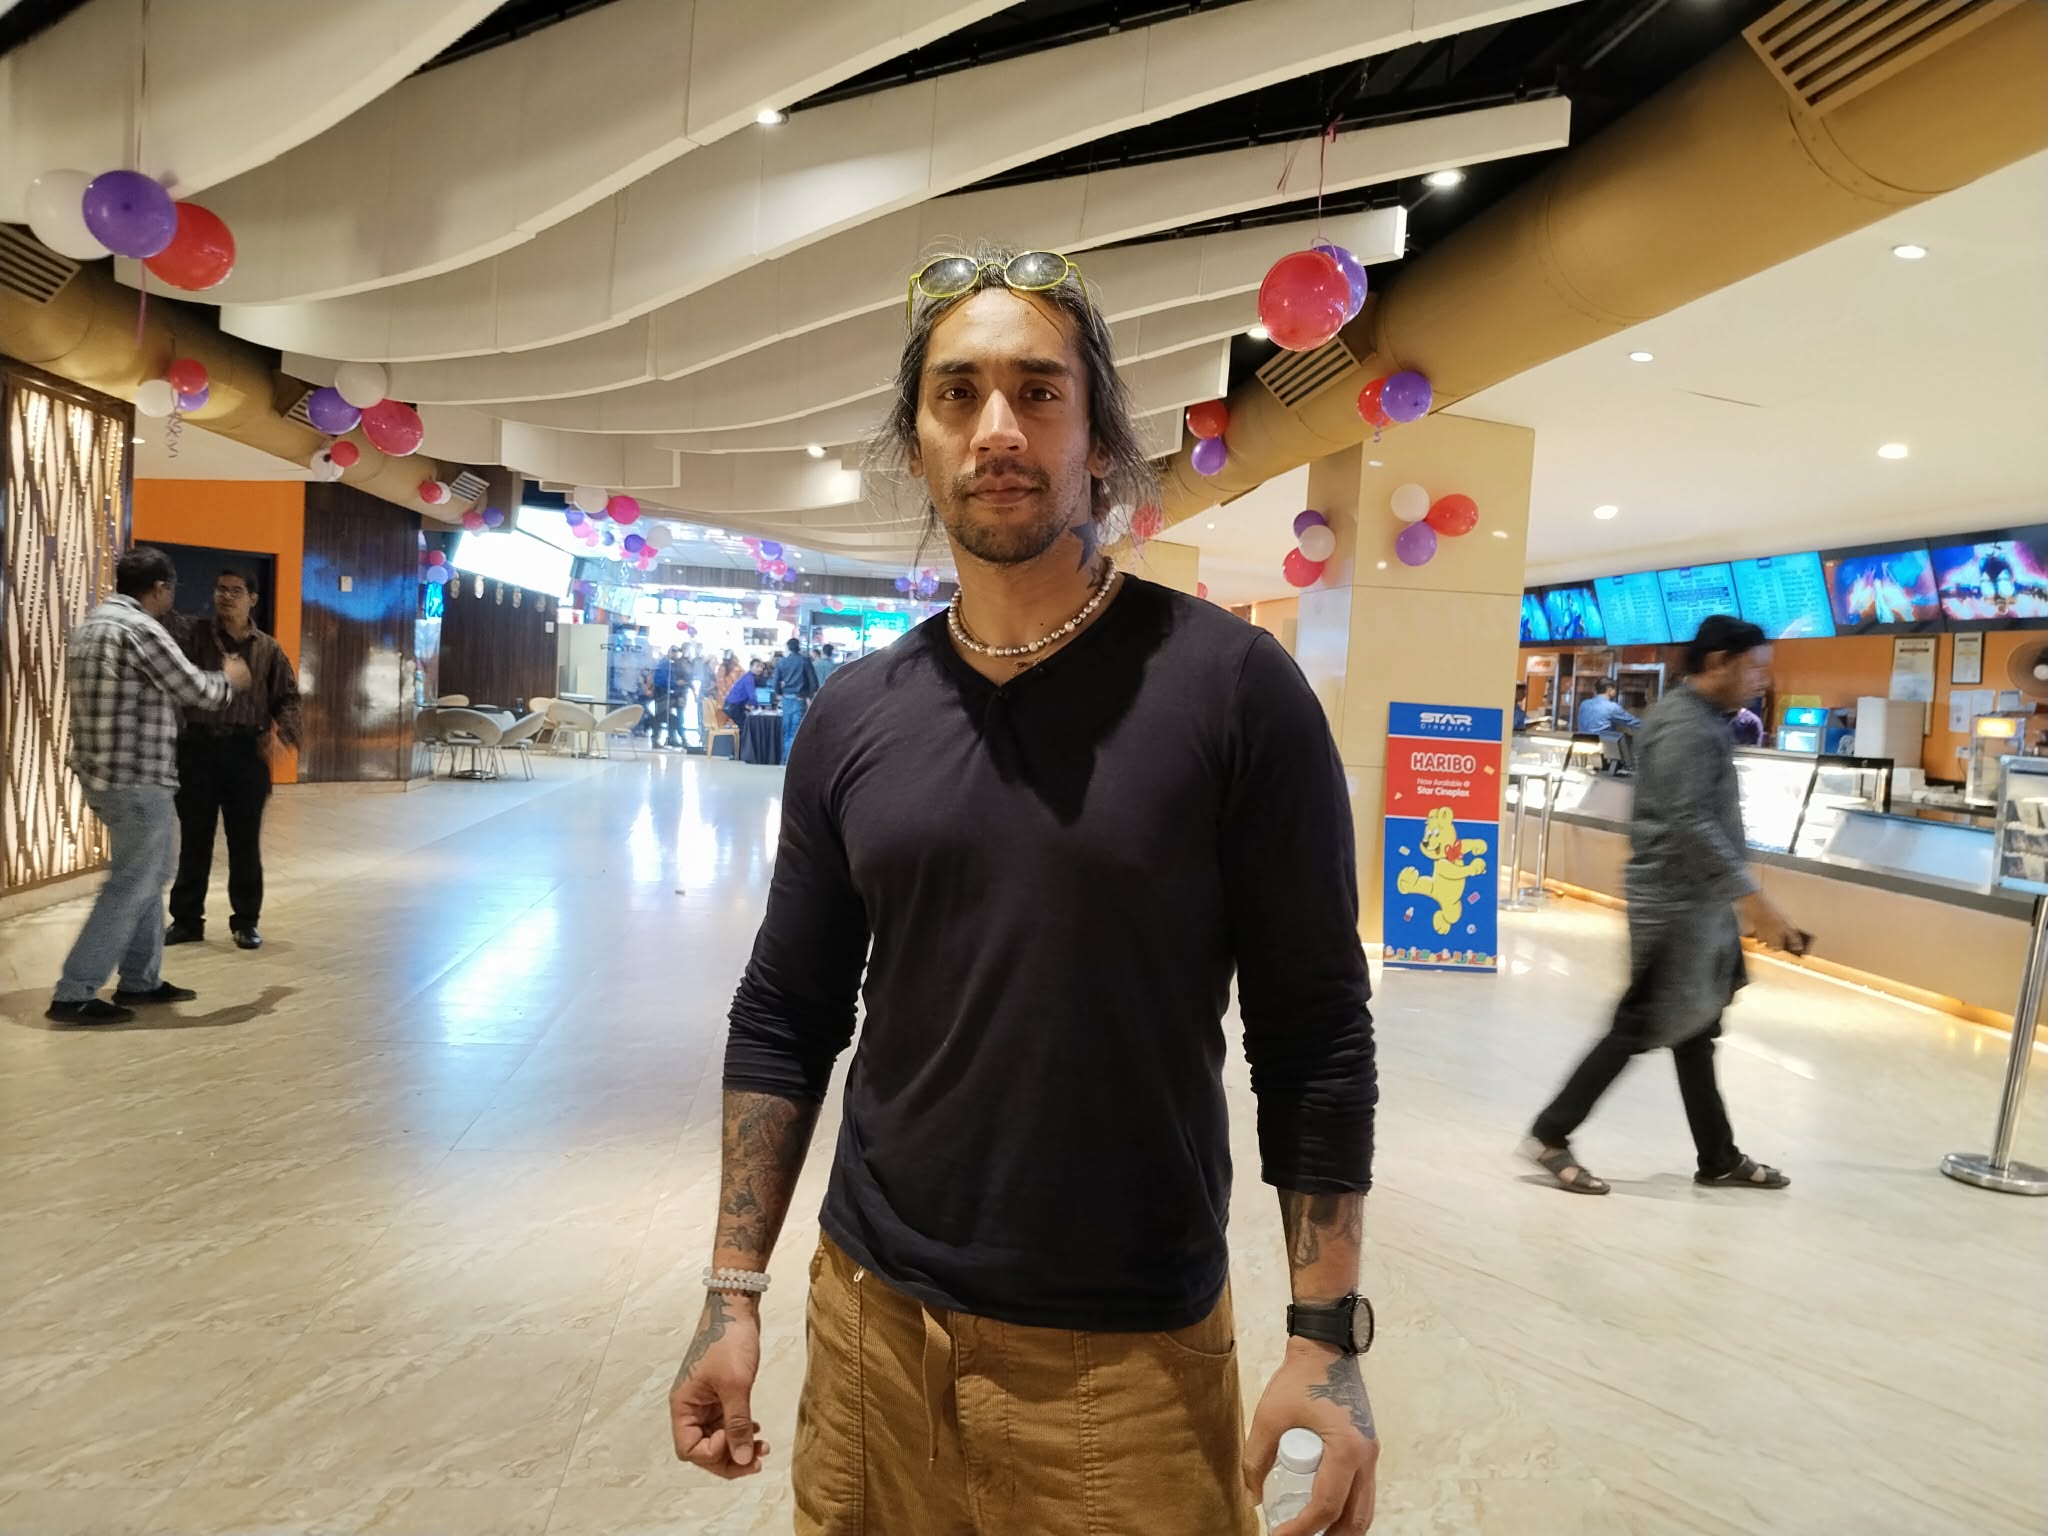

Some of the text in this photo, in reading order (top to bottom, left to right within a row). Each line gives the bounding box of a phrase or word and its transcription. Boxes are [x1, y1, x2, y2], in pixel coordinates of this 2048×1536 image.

[1420, 712, 1472, 725] STAR
[1411, 752, 1476, 774] HARIBO
[1417, 778, 1433, 786] Now
[1417, 786, 1470, 798] Star Cineplex
